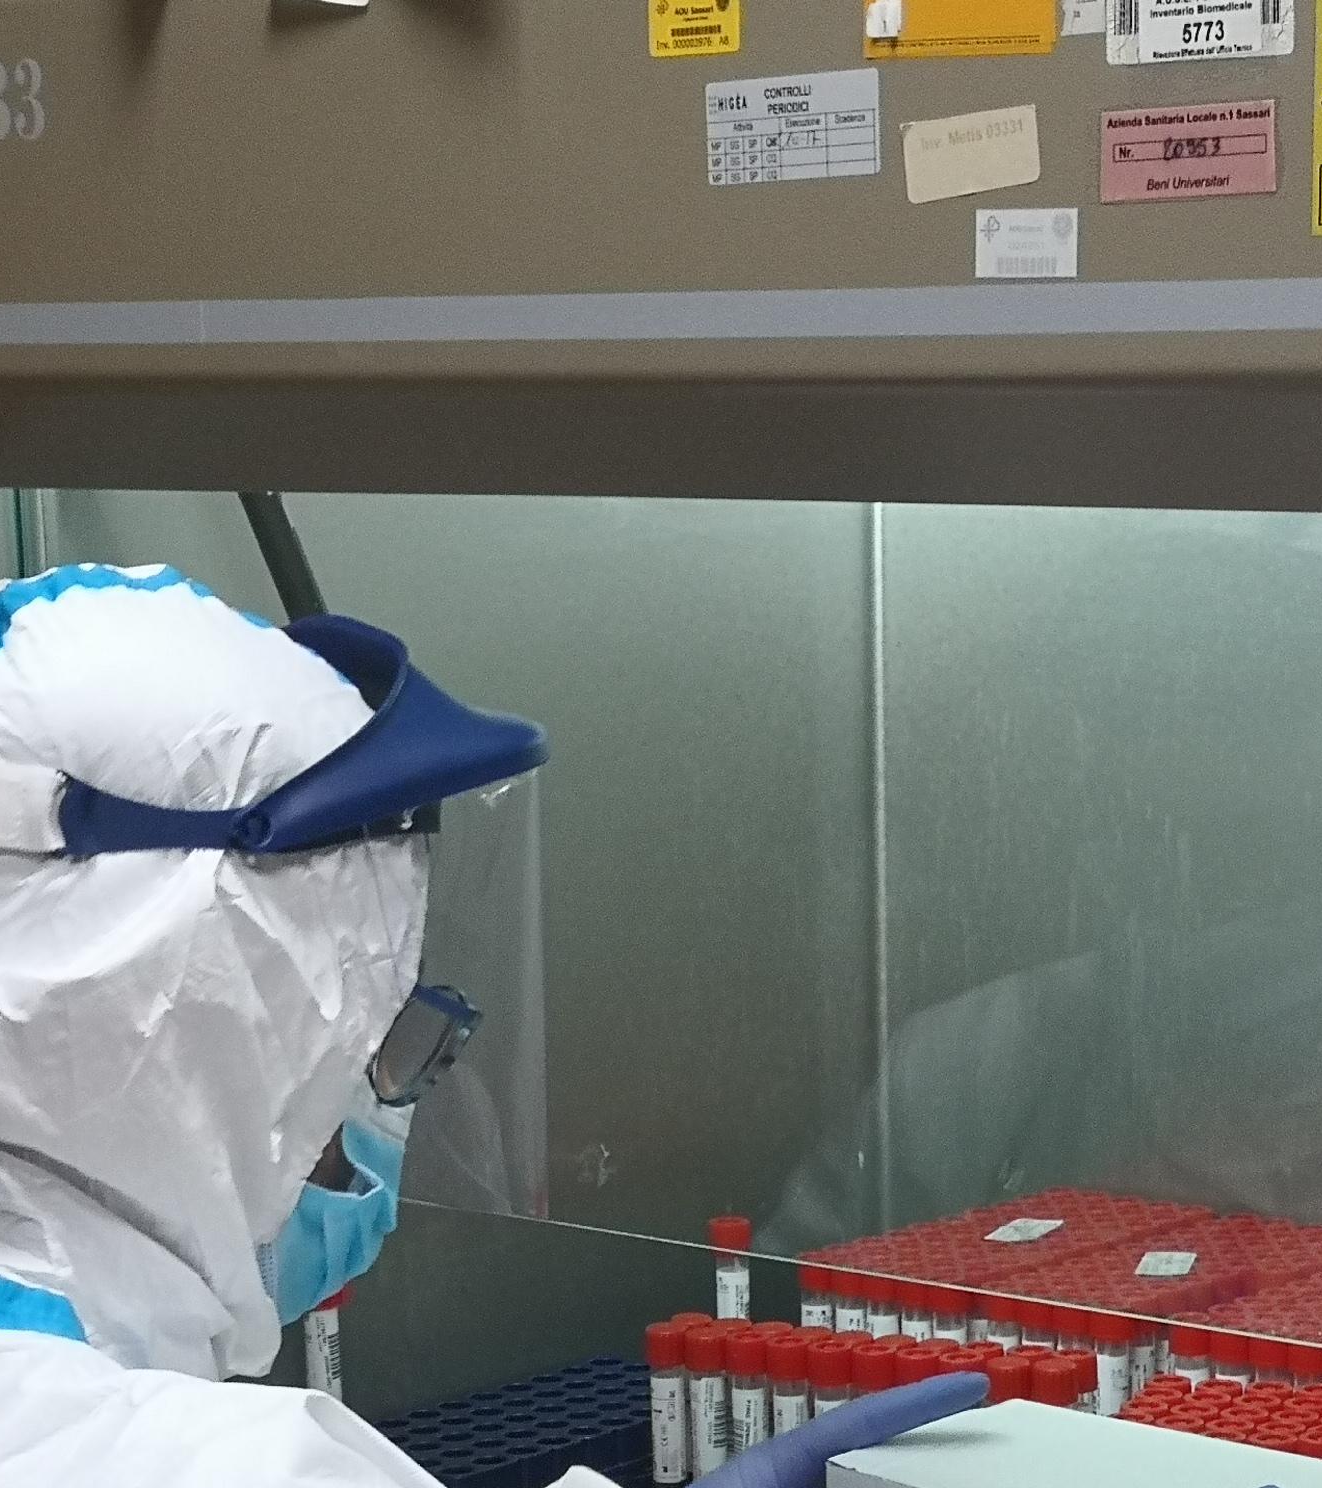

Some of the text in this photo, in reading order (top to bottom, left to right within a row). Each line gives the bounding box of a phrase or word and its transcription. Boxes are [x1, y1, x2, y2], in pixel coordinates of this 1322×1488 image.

[1150, 2, 1253, 19] Inventario Biomedicale
[1182, 20, 1225, 44] 5773
[764, 84, 812, 99] CONTROLLI
[767, 101, 809, 115] PERIODICI
[1107, 116, 1142, 129] Azienda
[1144, 114, 1185, 126] Sanitaria
[1187, 112, 1217, 123] Locale
[1235, 107, 1270, 120] Sassari
[1119, 147, 1135, 158] Nr.
[1147, 175, 1231, 191] Beni Universitari
